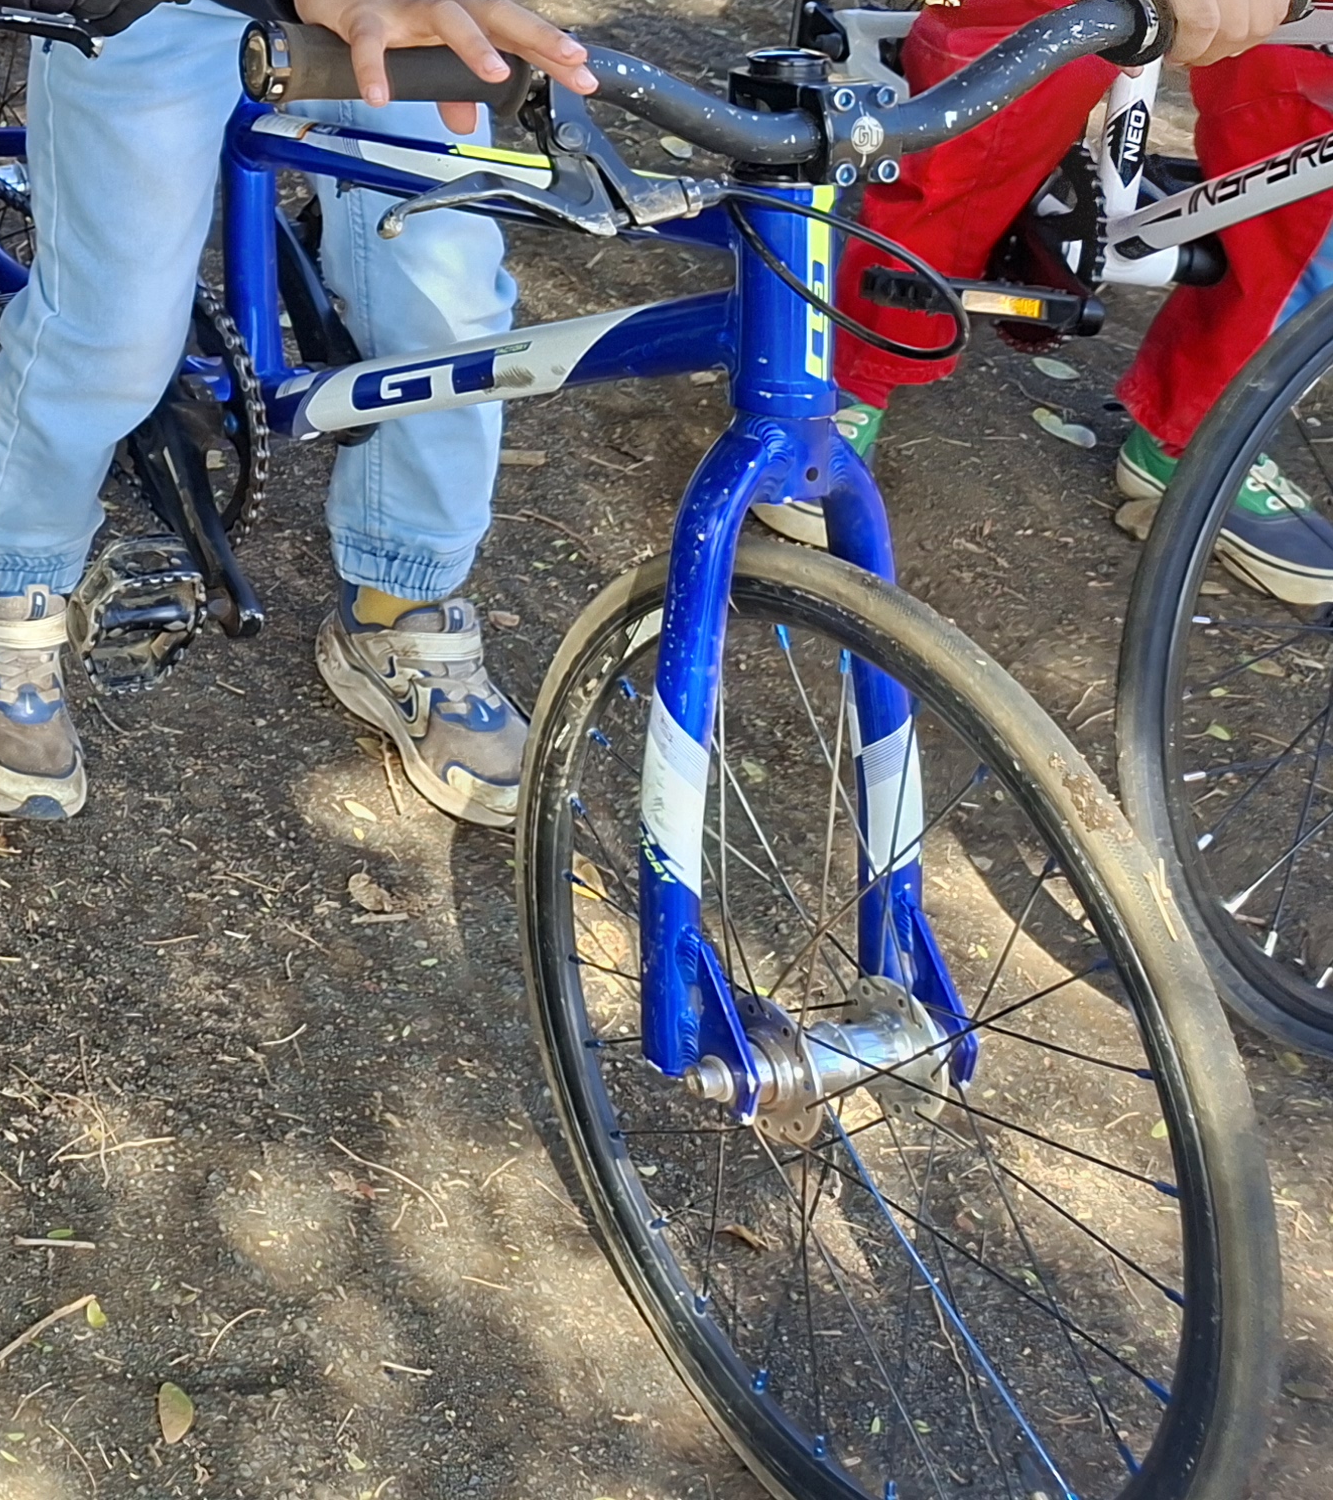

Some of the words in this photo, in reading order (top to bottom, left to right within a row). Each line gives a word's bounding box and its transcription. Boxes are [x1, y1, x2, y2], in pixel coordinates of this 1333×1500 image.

[852, 124, 881, 148] GT
[1123, 109, 1147, 162] NEO
[351, 348, 496, 412] GT
